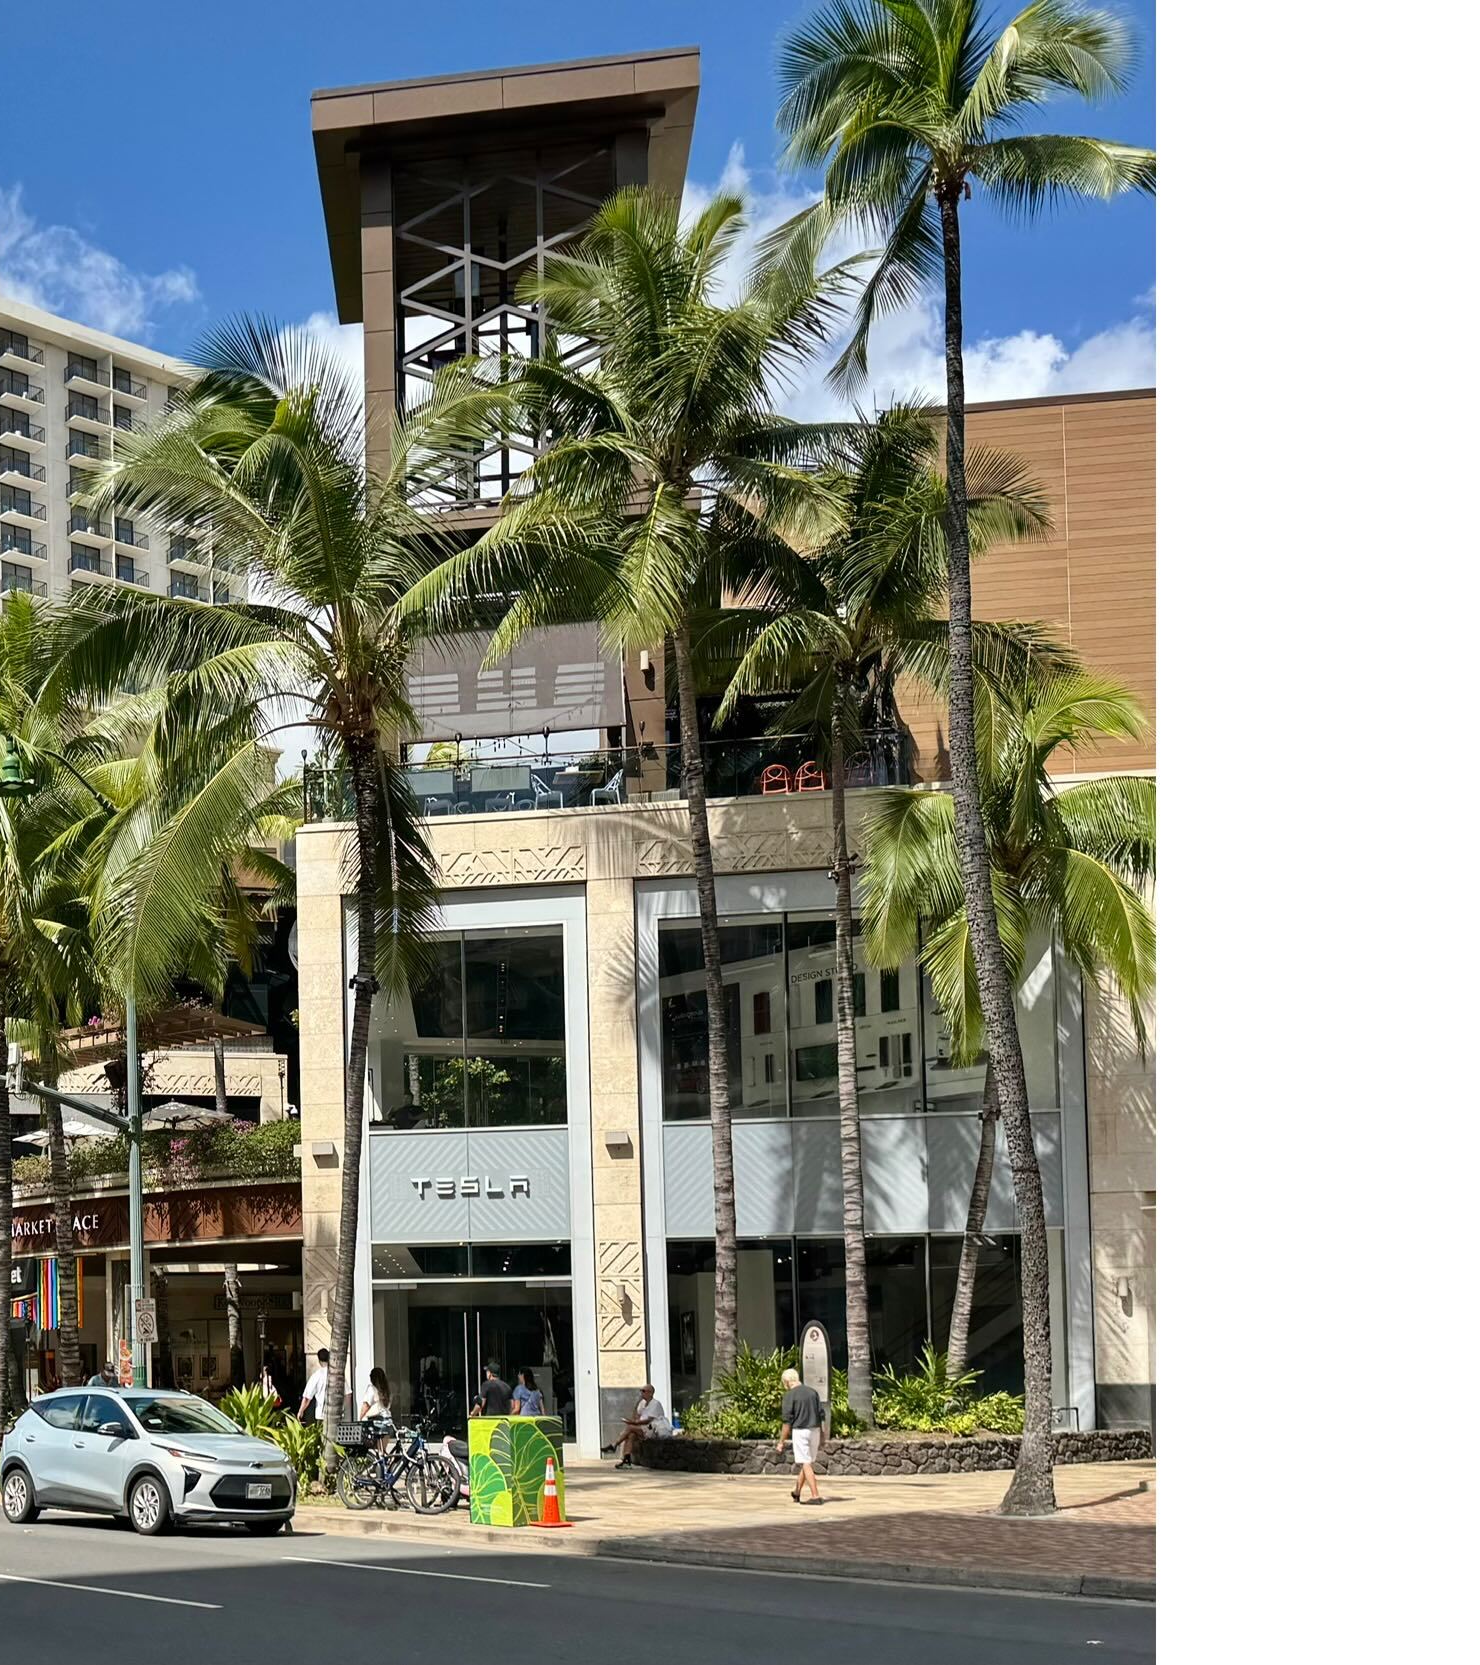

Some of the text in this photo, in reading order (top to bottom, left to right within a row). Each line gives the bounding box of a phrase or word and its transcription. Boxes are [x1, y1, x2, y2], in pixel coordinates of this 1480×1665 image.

[791, 963, 858, 984] DESIGN STO
[410, 1175, 529, 1198] TESLA
[70, 1214, 99, 1231] ACE
